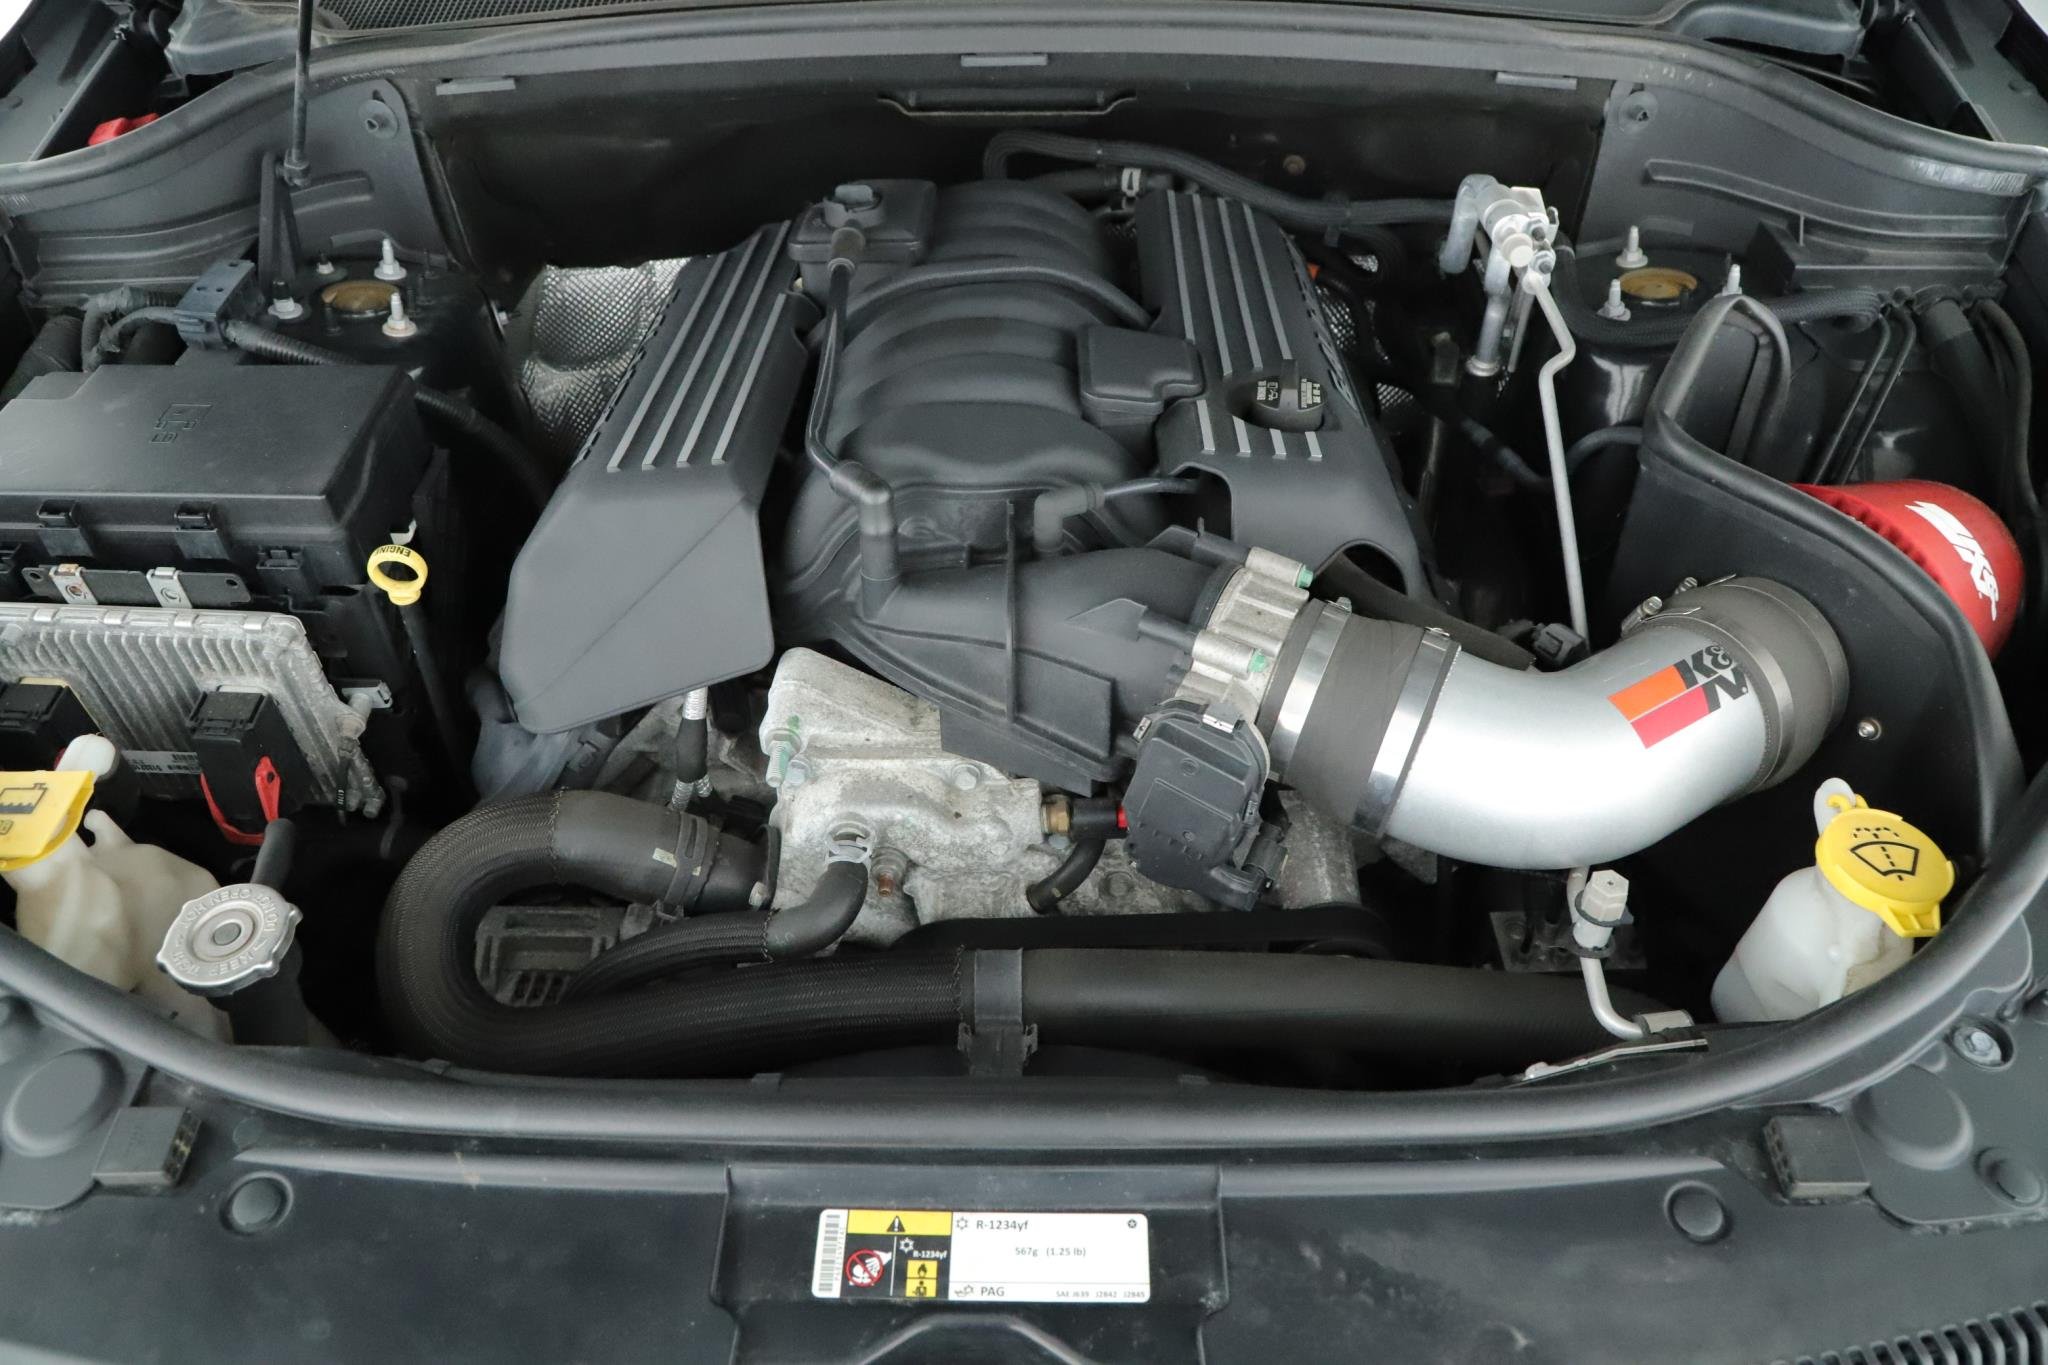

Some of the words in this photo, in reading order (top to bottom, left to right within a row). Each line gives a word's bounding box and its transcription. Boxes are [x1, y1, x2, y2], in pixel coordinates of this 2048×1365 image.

[209, 888, 252, 906] OPEN
[976, 1219, 1029, 1233] R-1234yf
[912, 1249, 948, 1260] R-1234yf
[1015, 1246, 1038, 1258] 567g
[1046, 1246, 1071, 1258] (1.25
[1073, 1246, 1087, 1258] lb)
[980, 1286, 1005, 1298] PAG
